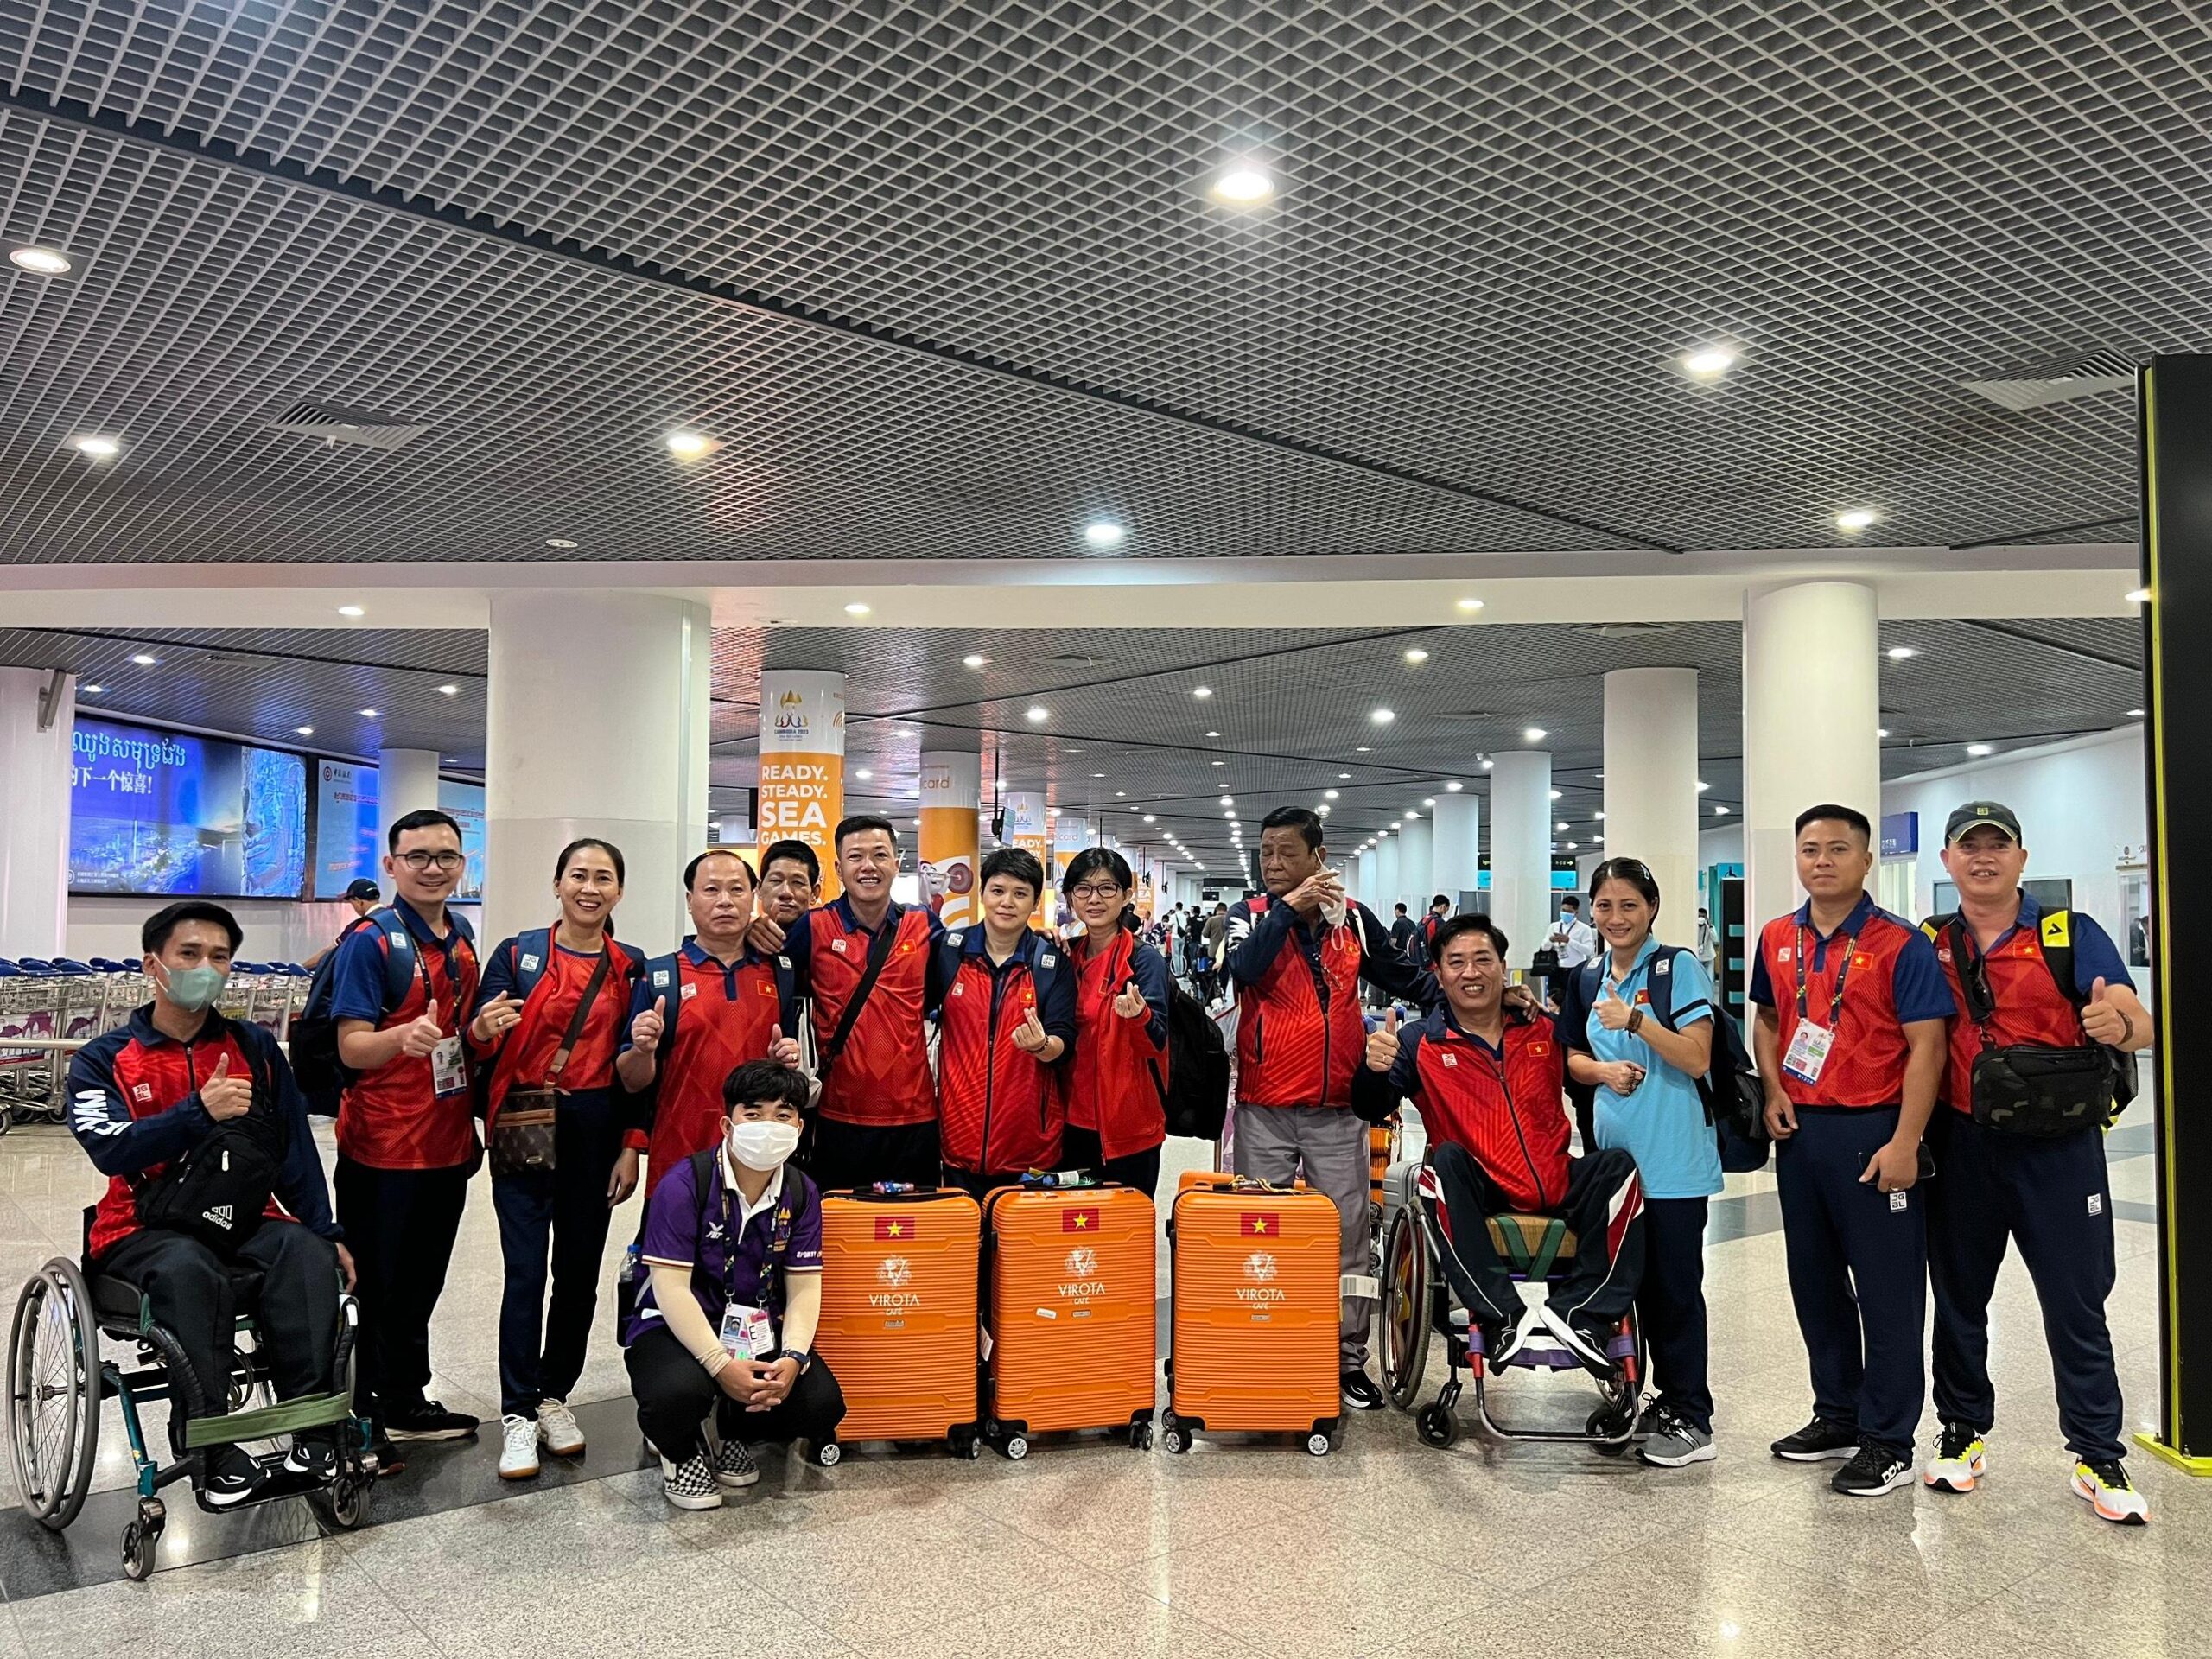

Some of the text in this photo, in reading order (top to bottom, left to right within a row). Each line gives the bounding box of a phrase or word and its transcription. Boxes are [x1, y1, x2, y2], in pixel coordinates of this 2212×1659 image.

[761, 765, 829, 781] READY.
[761, 784, 828, 798] STEADY.
[761, 801, 827, 828] SEA
[1013, 839, 1042, 848] EADY.
[202, 1211, 232, 1230] adidas
[1058, 1282, 1106, 1296] VIROTA
[1236, 1288, 1286, 1301] VIROTA
[868, 1294, 920, 1306] VIROTA
[749, 1325, 758, 1340] E
